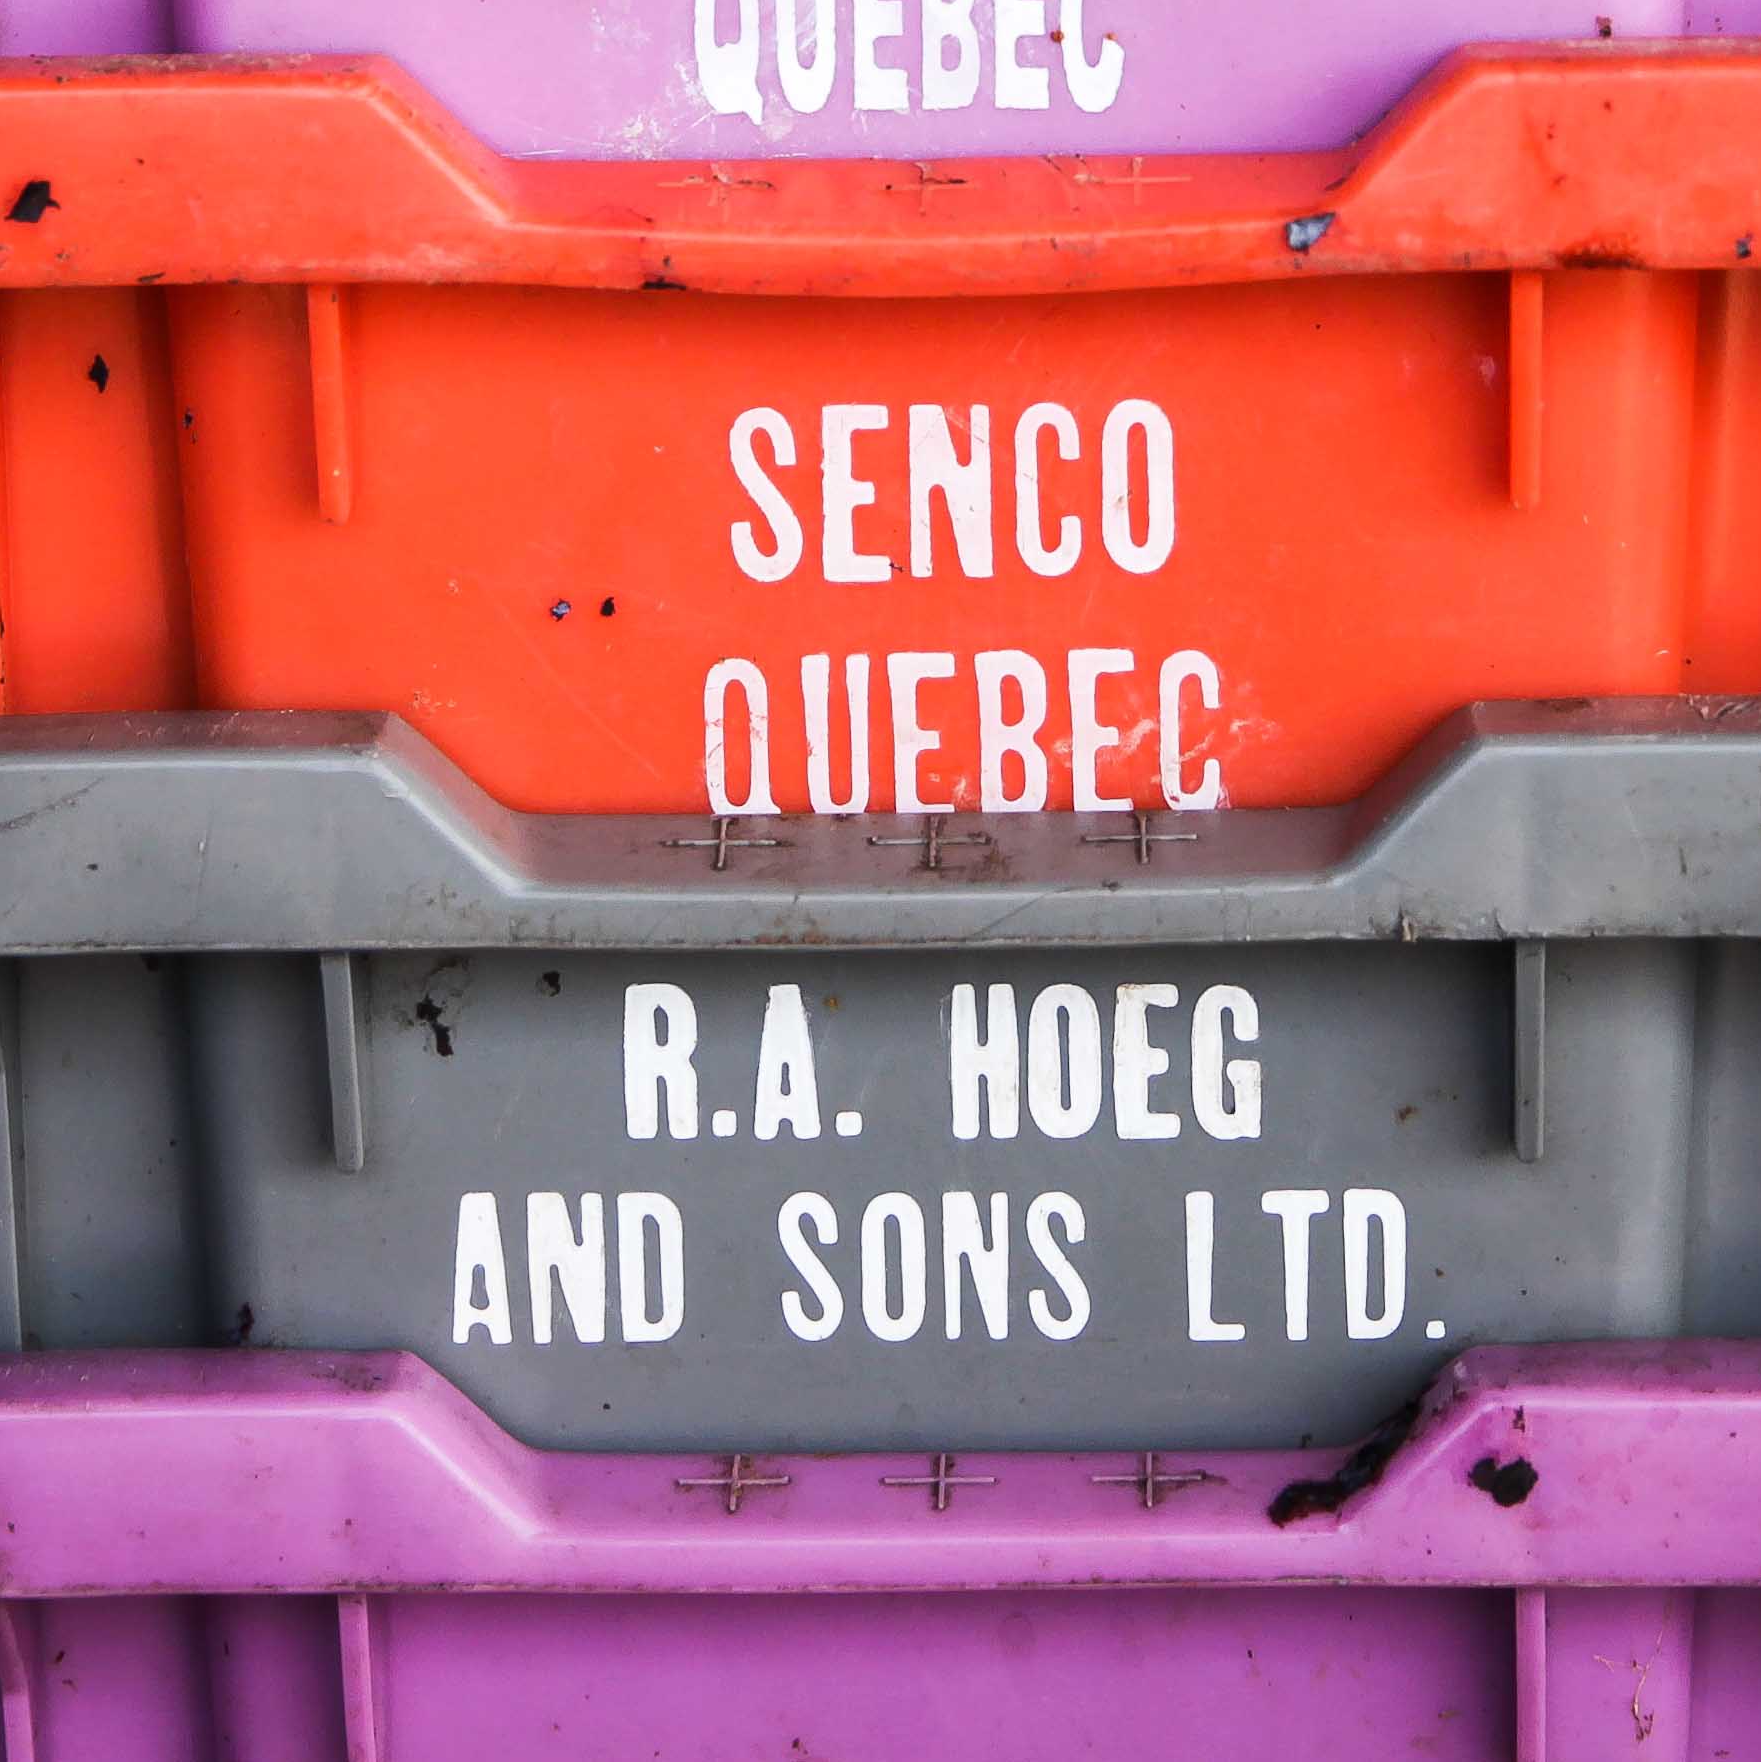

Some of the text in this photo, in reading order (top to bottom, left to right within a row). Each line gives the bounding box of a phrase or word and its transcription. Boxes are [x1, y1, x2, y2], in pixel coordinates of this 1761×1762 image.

[729, 398, 1176, 584] SENCO
[704, 647, 1225, 816] QUEBEC
[623, 983, 1262, 1140] R.A. HOEG
[452, 1188, 1447, 1345] AND SONS LTD.
